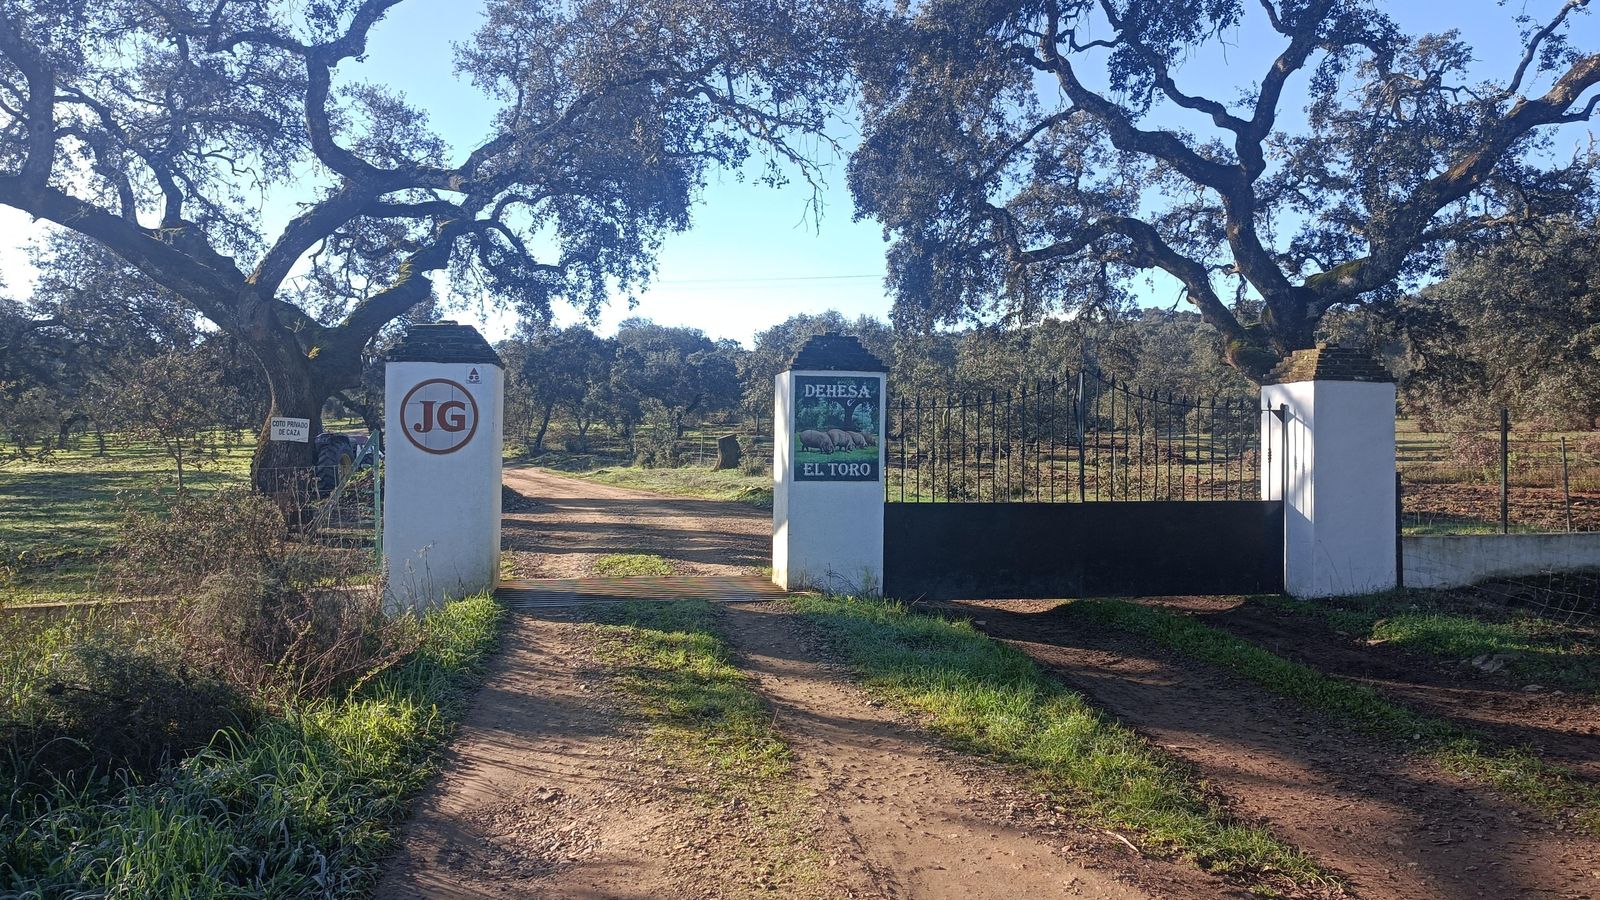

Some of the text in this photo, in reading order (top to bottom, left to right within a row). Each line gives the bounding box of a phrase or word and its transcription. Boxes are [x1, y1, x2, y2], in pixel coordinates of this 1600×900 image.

[804, 384, 871, 398] DEHESA
[414, 401, 465, 432] JG
[287, 421, 308, 429] PRIVADO
[803, 463, 871, 476] EL TORO
